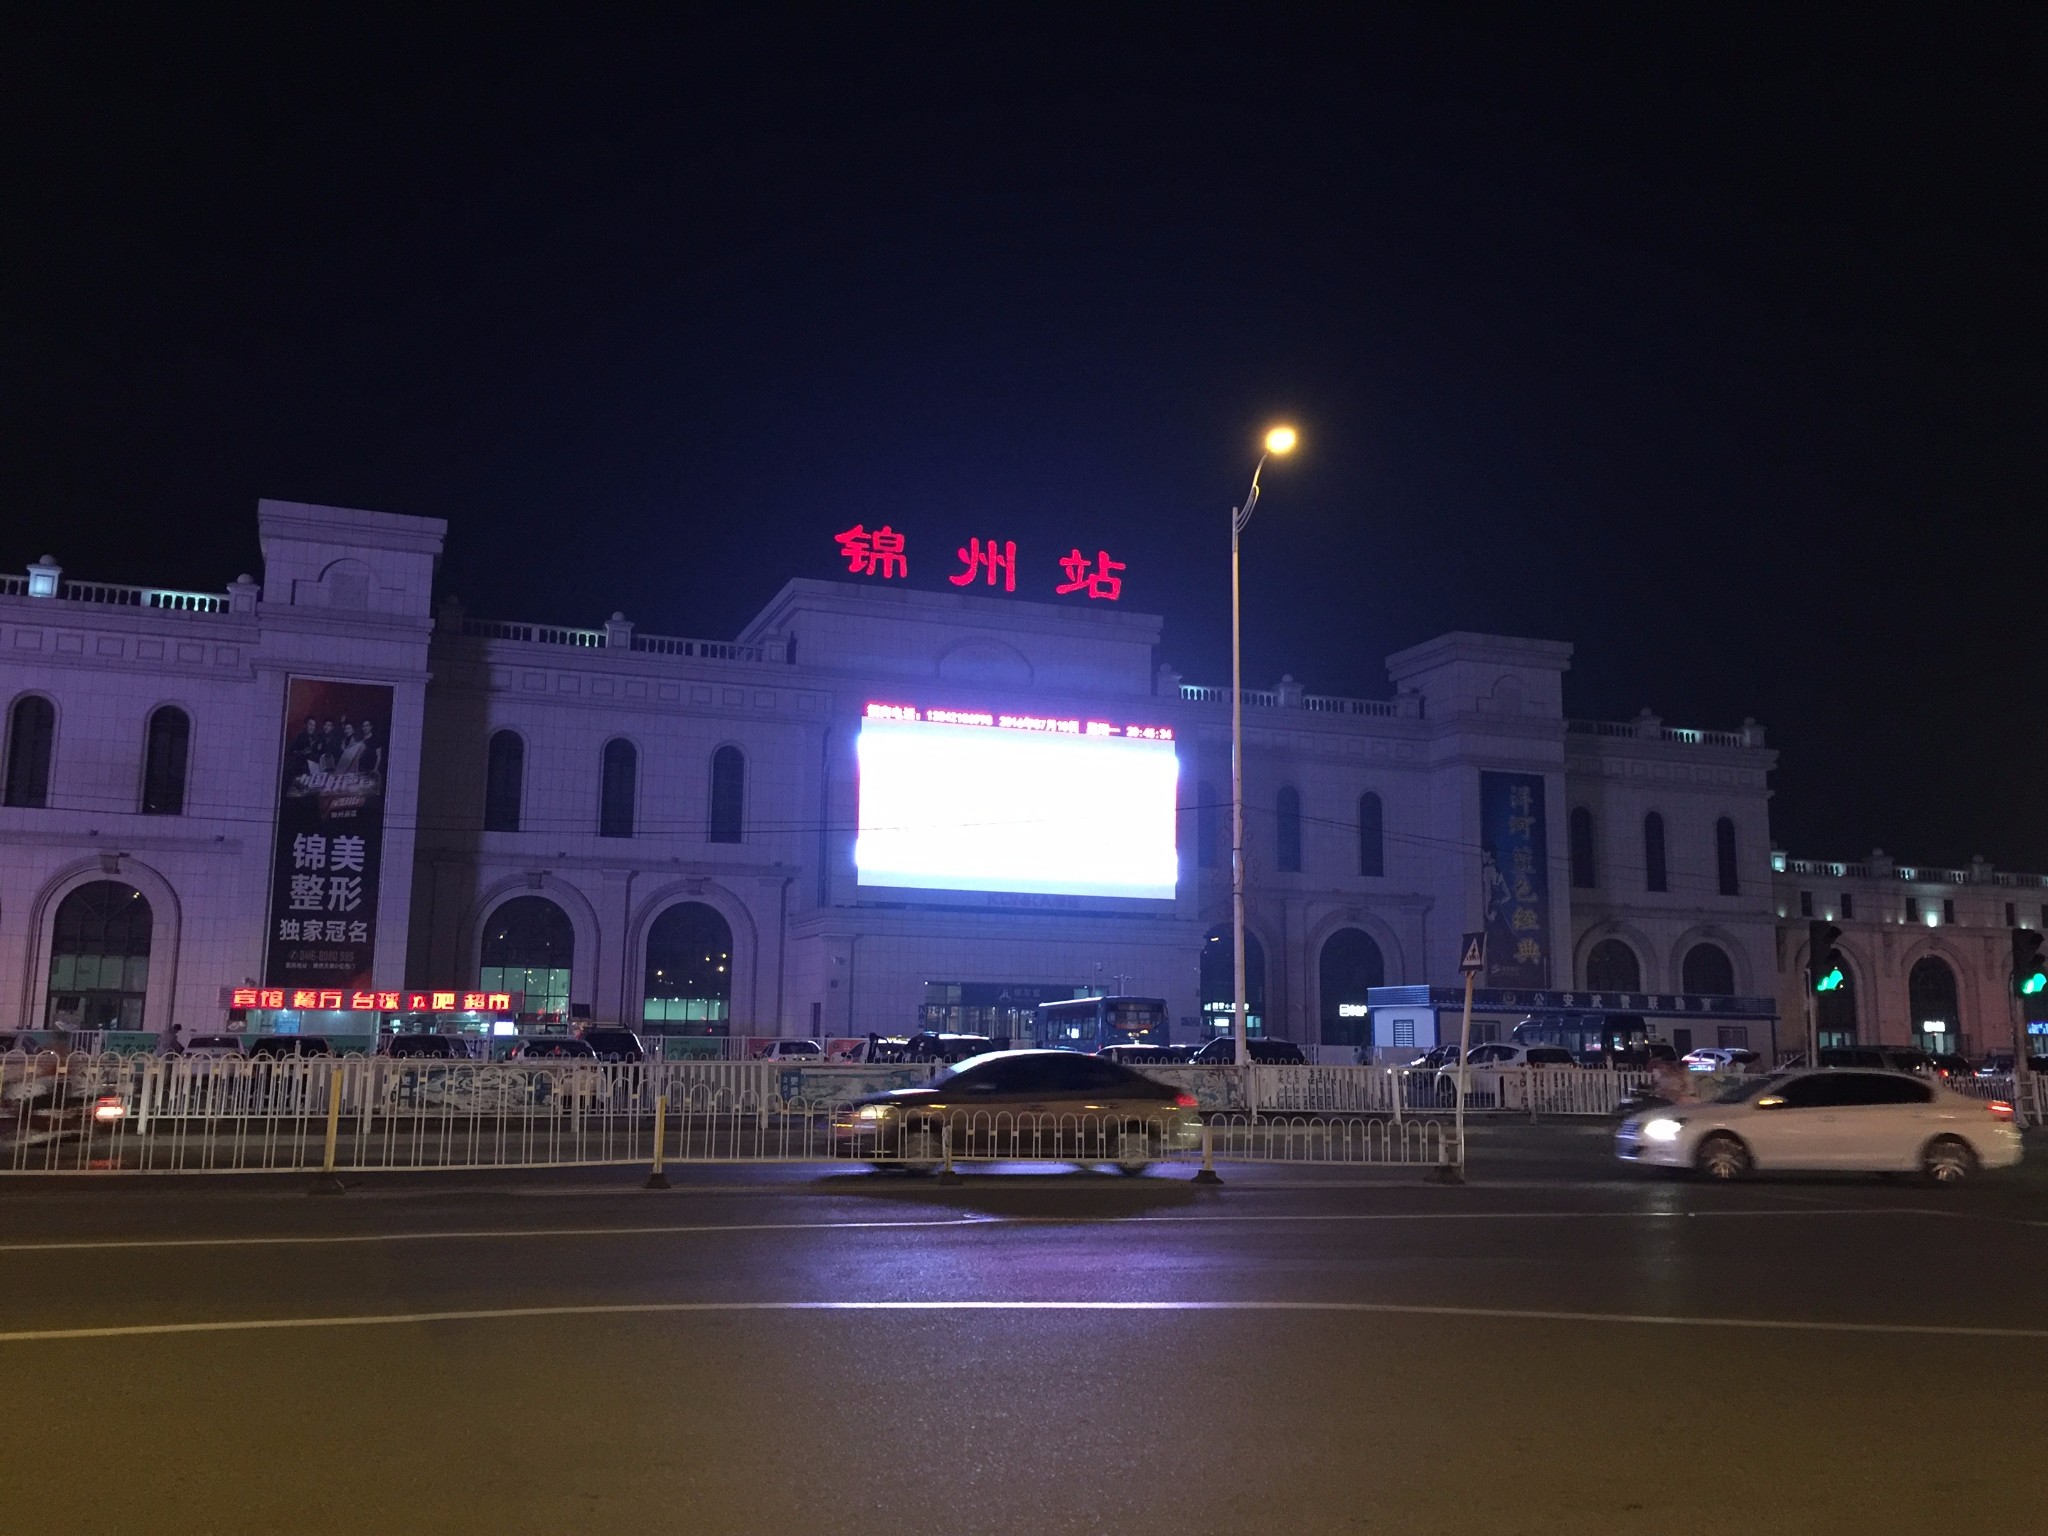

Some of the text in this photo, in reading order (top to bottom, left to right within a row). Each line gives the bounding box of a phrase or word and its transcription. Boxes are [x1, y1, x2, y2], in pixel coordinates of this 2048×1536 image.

[834, 524, 1127, 602] 锦州站
[292, 832, 366, 873] 锦美
[289, 873, 362, 912] 整形
[279, 919, 368, 943] 独家冠名
[231, 988, 284, 1008] 宾馆
[293, 990, 343, 1009] 餐厅
[352, 991, 400, 1010] 台球
[463, 993, 510, 1010] 超市
